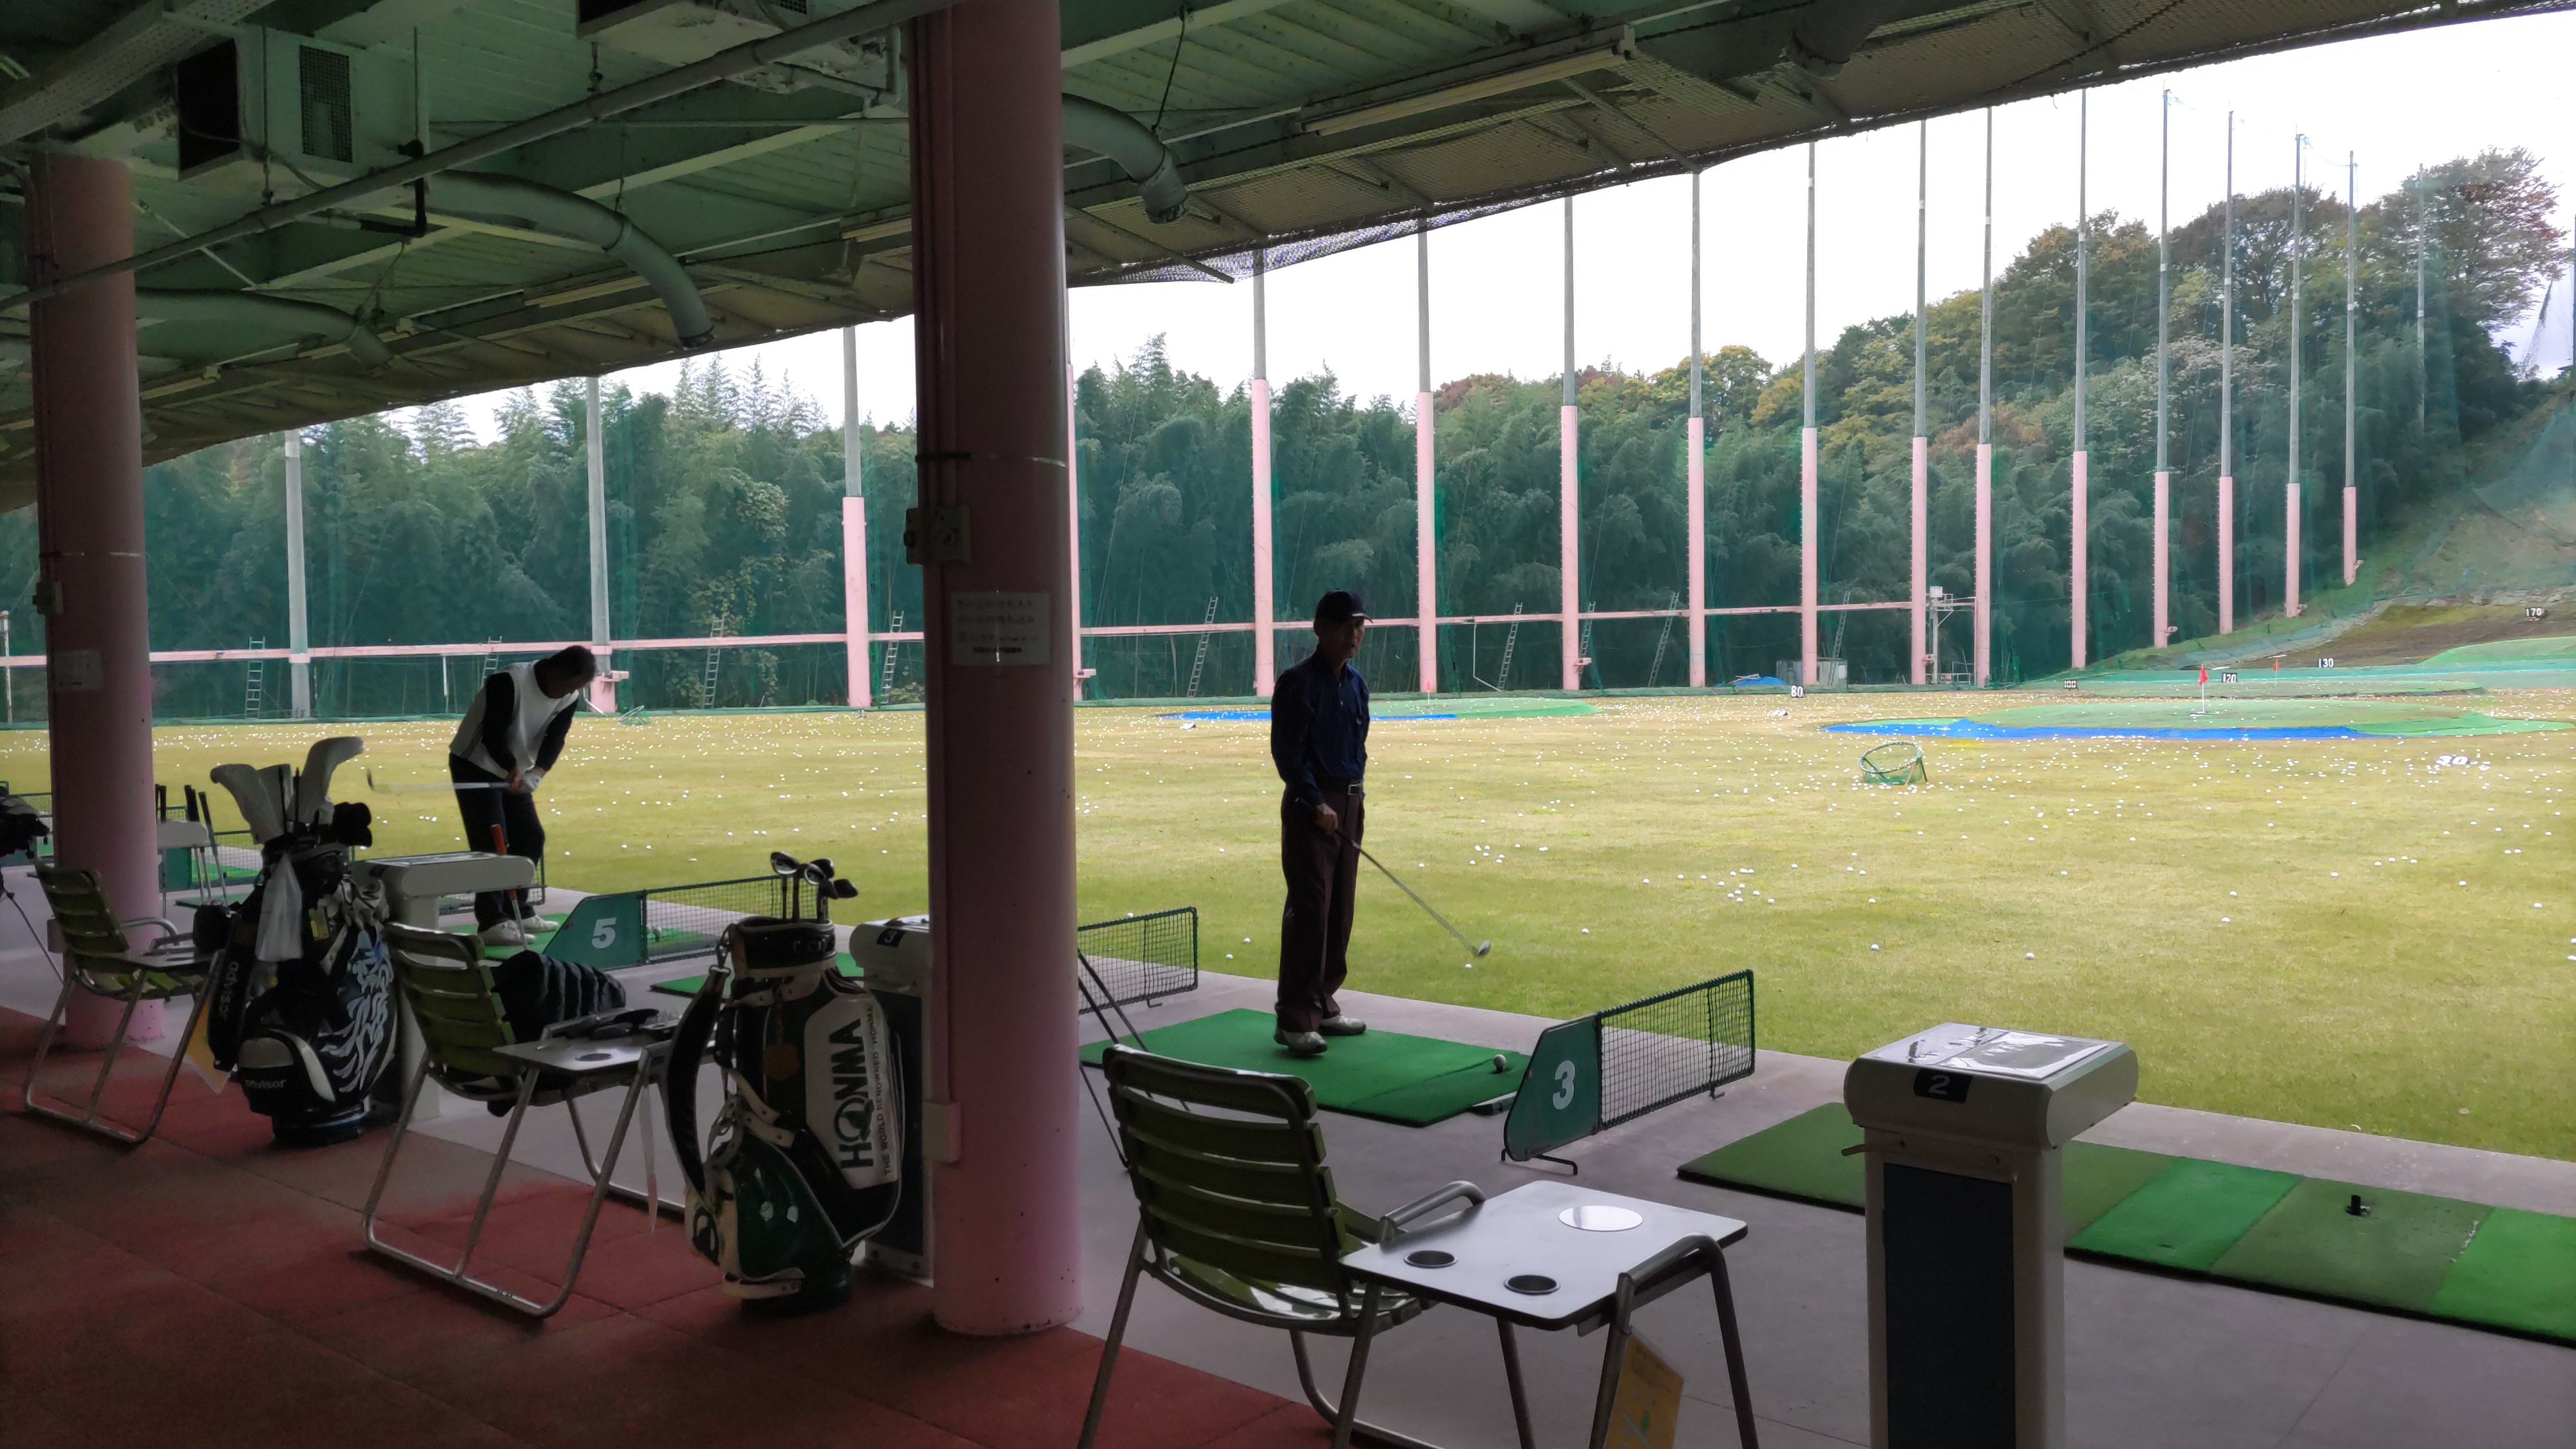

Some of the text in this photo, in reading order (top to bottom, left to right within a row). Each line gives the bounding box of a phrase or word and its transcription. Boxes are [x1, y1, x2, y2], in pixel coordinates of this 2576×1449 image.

[2526, 608, 2542, 616] 170
[2318, 658, 2334, 668] 130
[2223, 673, 2237, 683] 120
[1791, 685, 1803, 697] 80
[2436, 755, 2468, 765] 30
[591, 917, 618, 949] 5
[872, 1052, 884, 1111] RENOWNED
[1552, 1060, 1576, 1110] 3
[1927, 1074, 1951, 1095] 2
[829, 1018, 874, 1169] HONMA
[876, 1113, 888, 1151] WORLD
[881, 1154, 891, 1176] THE
